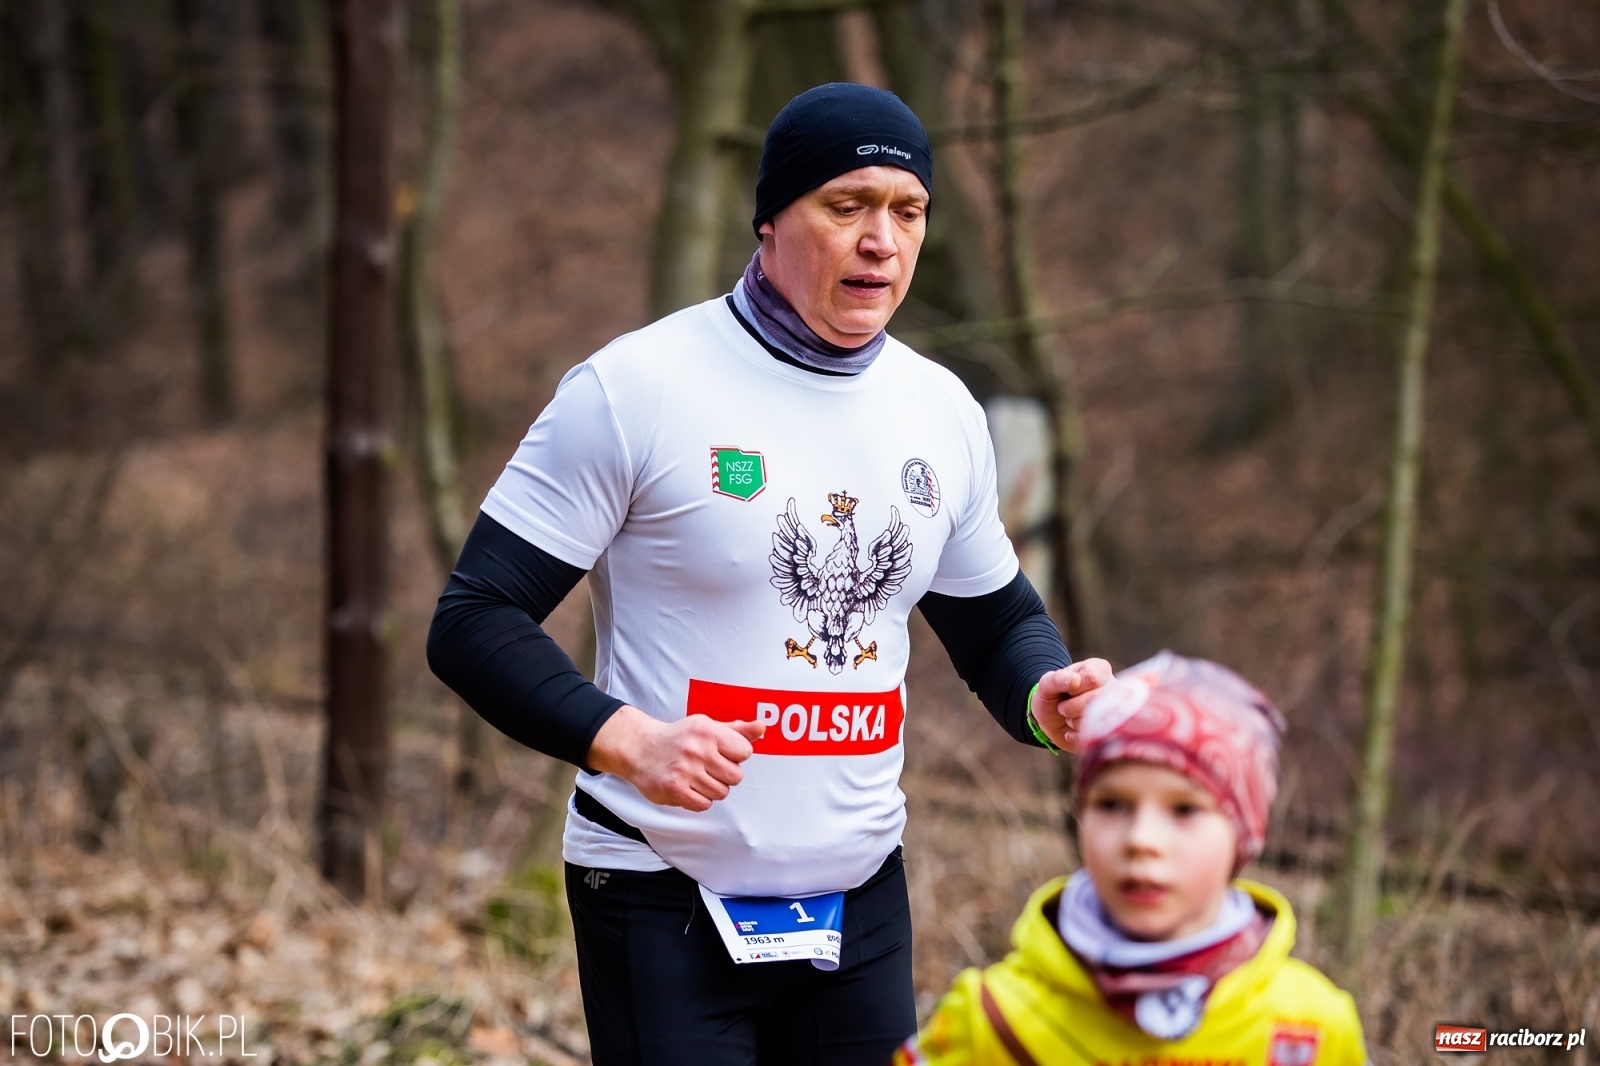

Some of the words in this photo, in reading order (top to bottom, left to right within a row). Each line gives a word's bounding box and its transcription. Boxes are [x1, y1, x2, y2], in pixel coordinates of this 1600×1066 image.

[881, 145, 911, 159] Kalenji
[726, 461, 754, 472] NSZZ
[729, 473, 753, 485] FSG
[757, 702, 886, 742] POLSKA
[583, 869, 610, 890] 4F
[789, 902, 815, 923] 1
[743, 936, 772, 945] 1963
